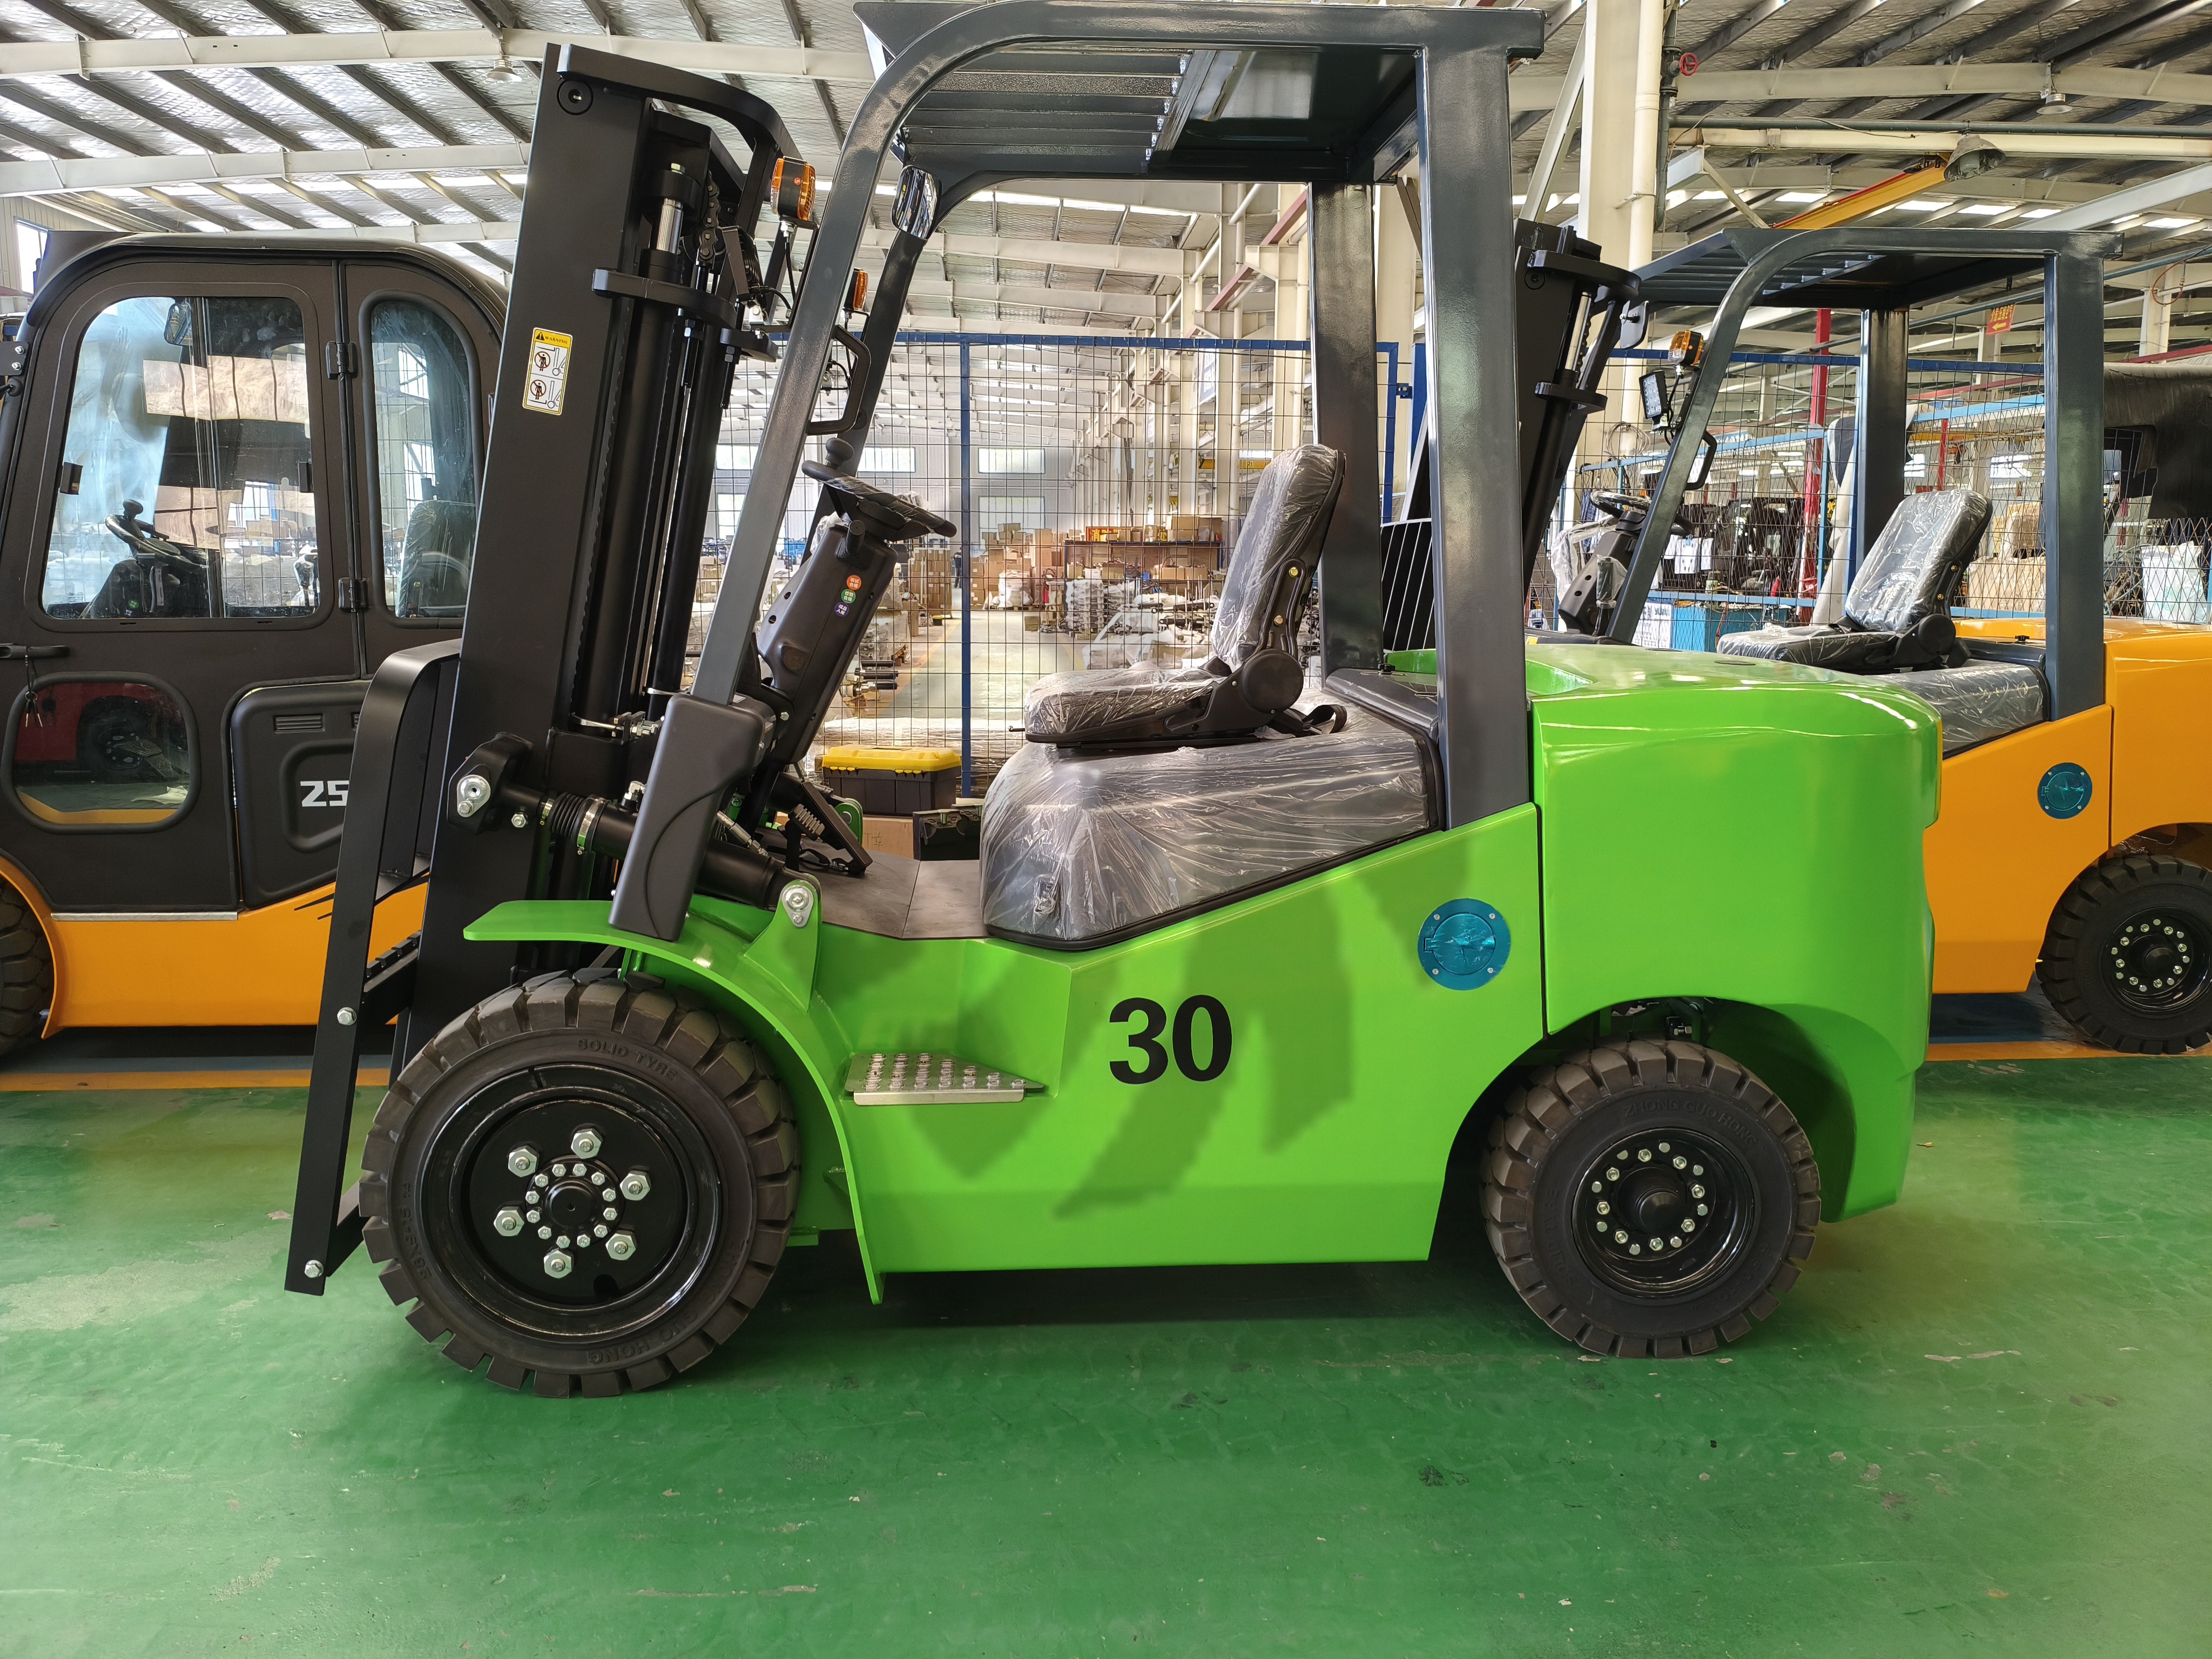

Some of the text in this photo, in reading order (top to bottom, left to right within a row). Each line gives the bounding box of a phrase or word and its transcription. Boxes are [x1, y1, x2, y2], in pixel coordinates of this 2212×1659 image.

[545, 336, 568, 344] WARNING
[578, 1037, 678, 1081] SOLID TYRE
[1109, 994, 1232, 1084] 30
[1623, 1098, 1757, 1146] ZHONG GUO HONG
[586, 1337, 651, 1364] HONG
